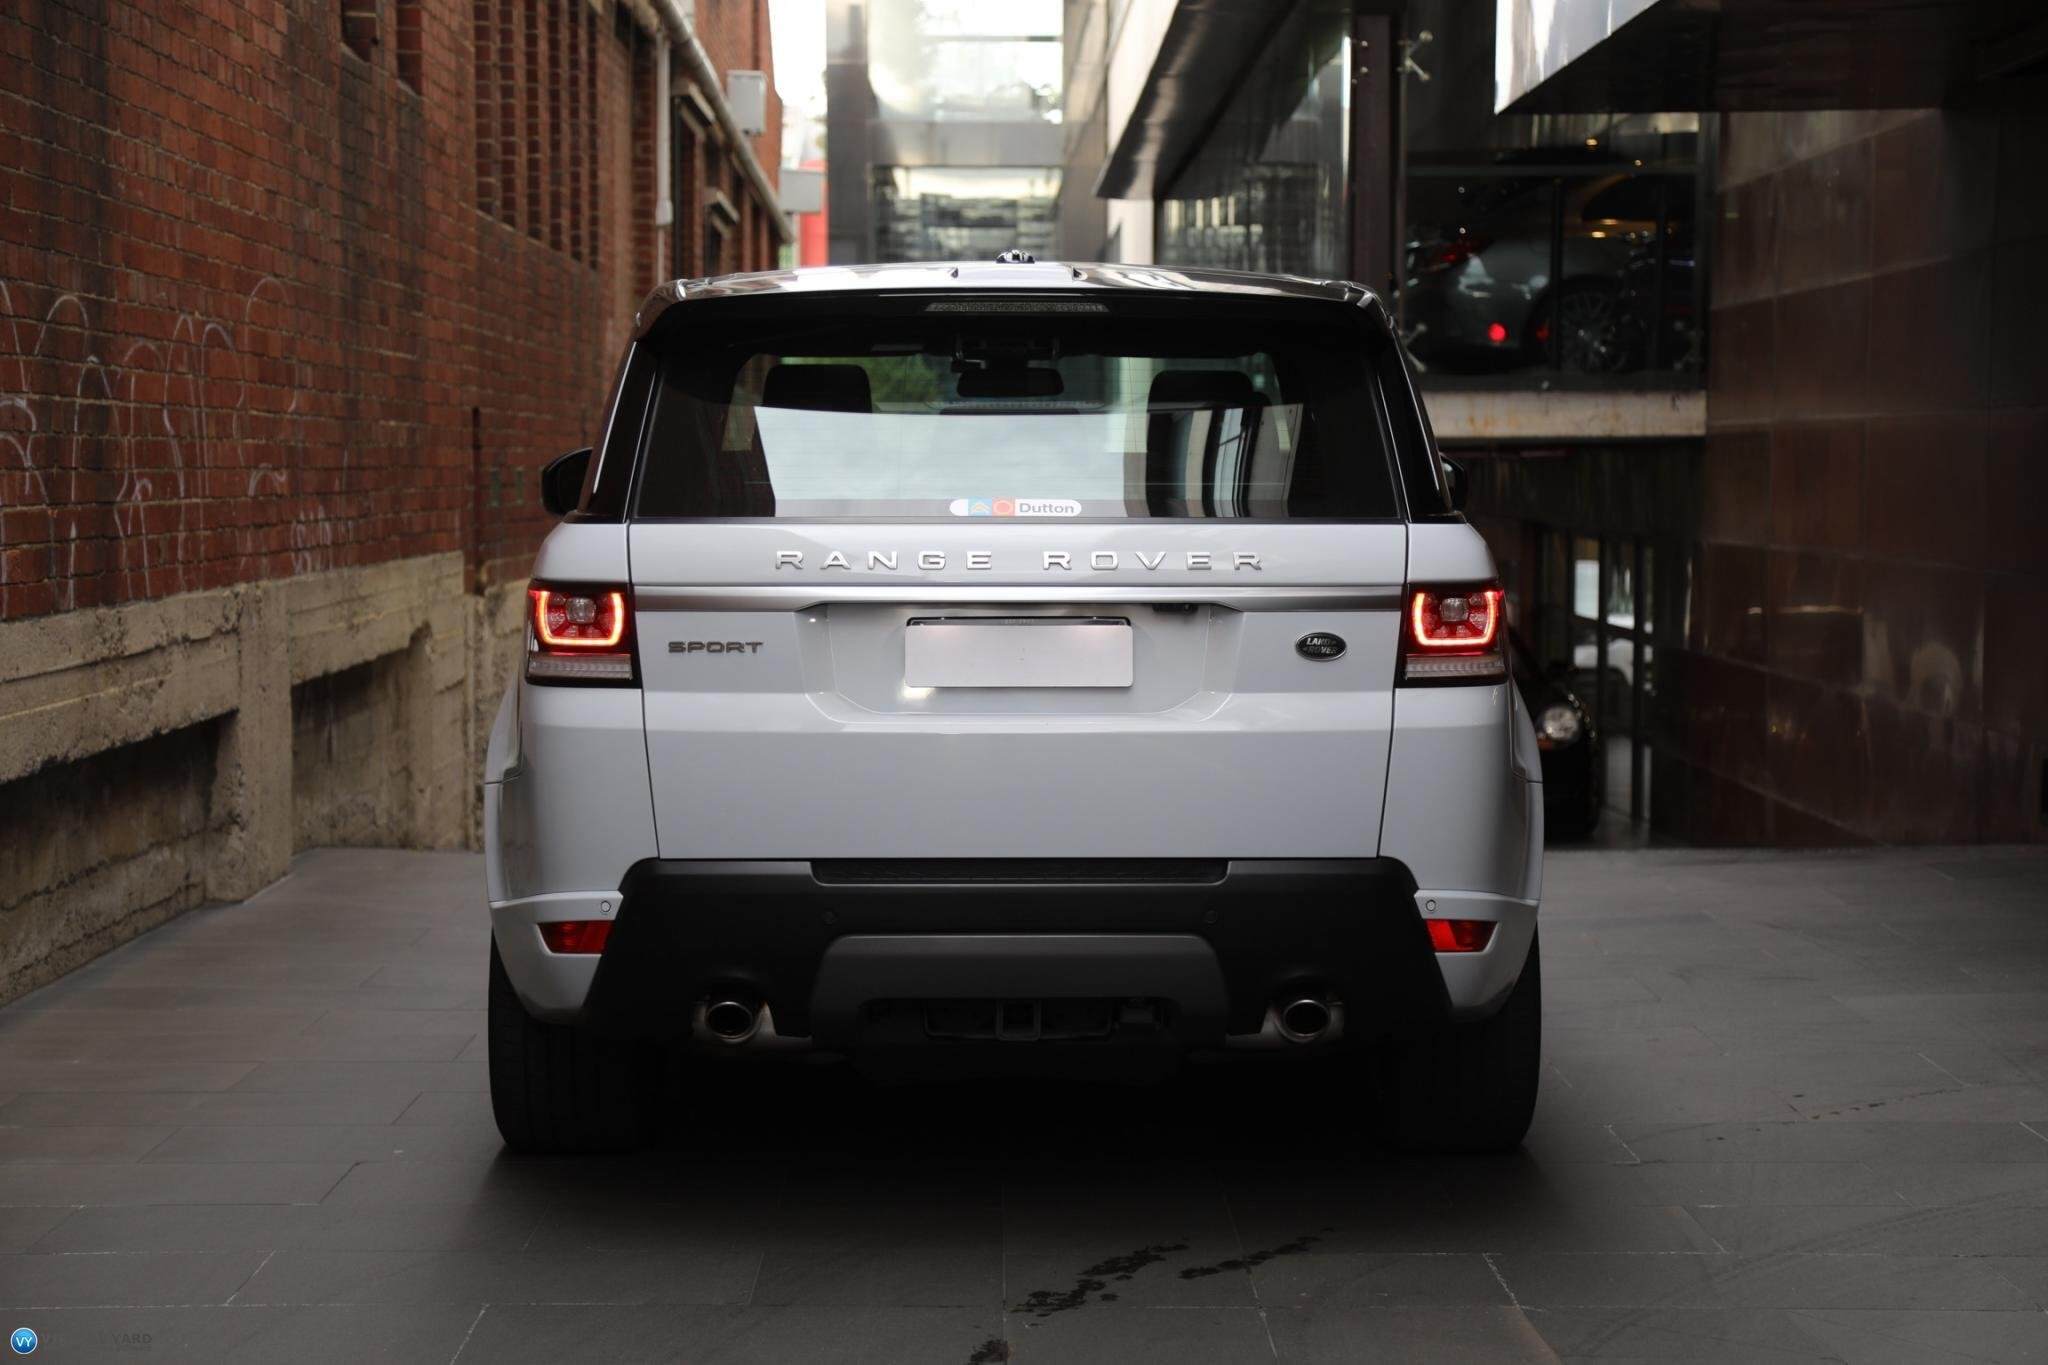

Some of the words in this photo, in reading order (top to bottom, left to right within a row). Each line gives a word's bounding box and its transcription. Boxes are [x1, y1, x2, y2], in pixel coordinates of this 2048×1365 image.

[1019, 502, 1075, 514] Dutton
[775, 550, 993, 570] RANGE
[1042, 551, 1262, 571] ROVER
[668, 641, 764, 654] SPORT
[1305, 637, 1331, 646] LAND
